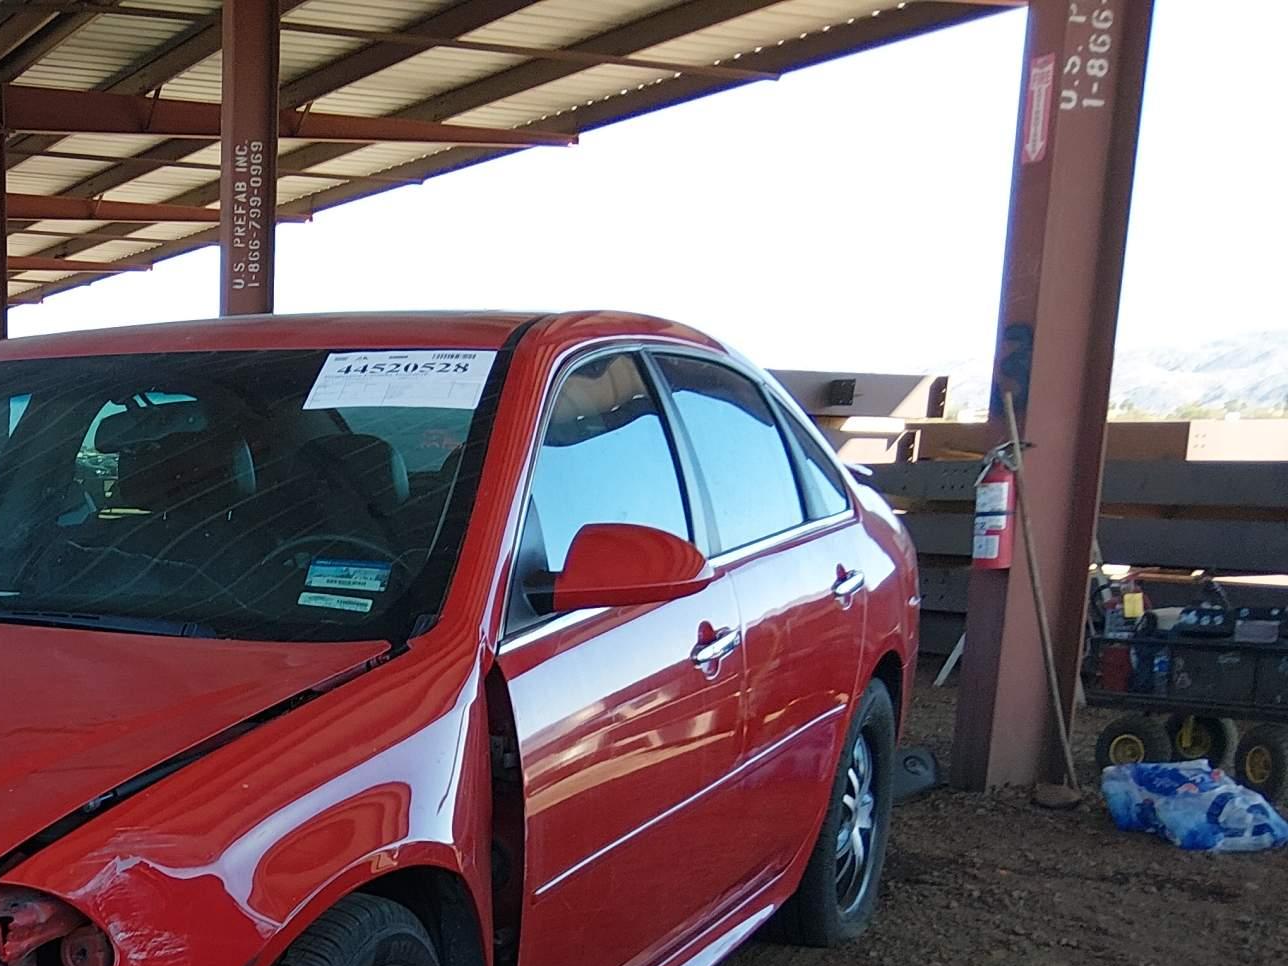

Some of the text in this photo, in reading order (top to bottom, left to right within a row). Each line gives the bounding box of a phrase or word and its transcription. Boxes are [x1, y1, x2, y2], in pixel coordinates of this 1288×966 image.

[1059, 44, 1083, 110] U.S.
[235, 139, 249, 172] INC.
[233, 181, 247, 248] PREFAB
[248, 141, 263, 287] 1-866-799-0969
[336, 361, 470, 375] 44520528
